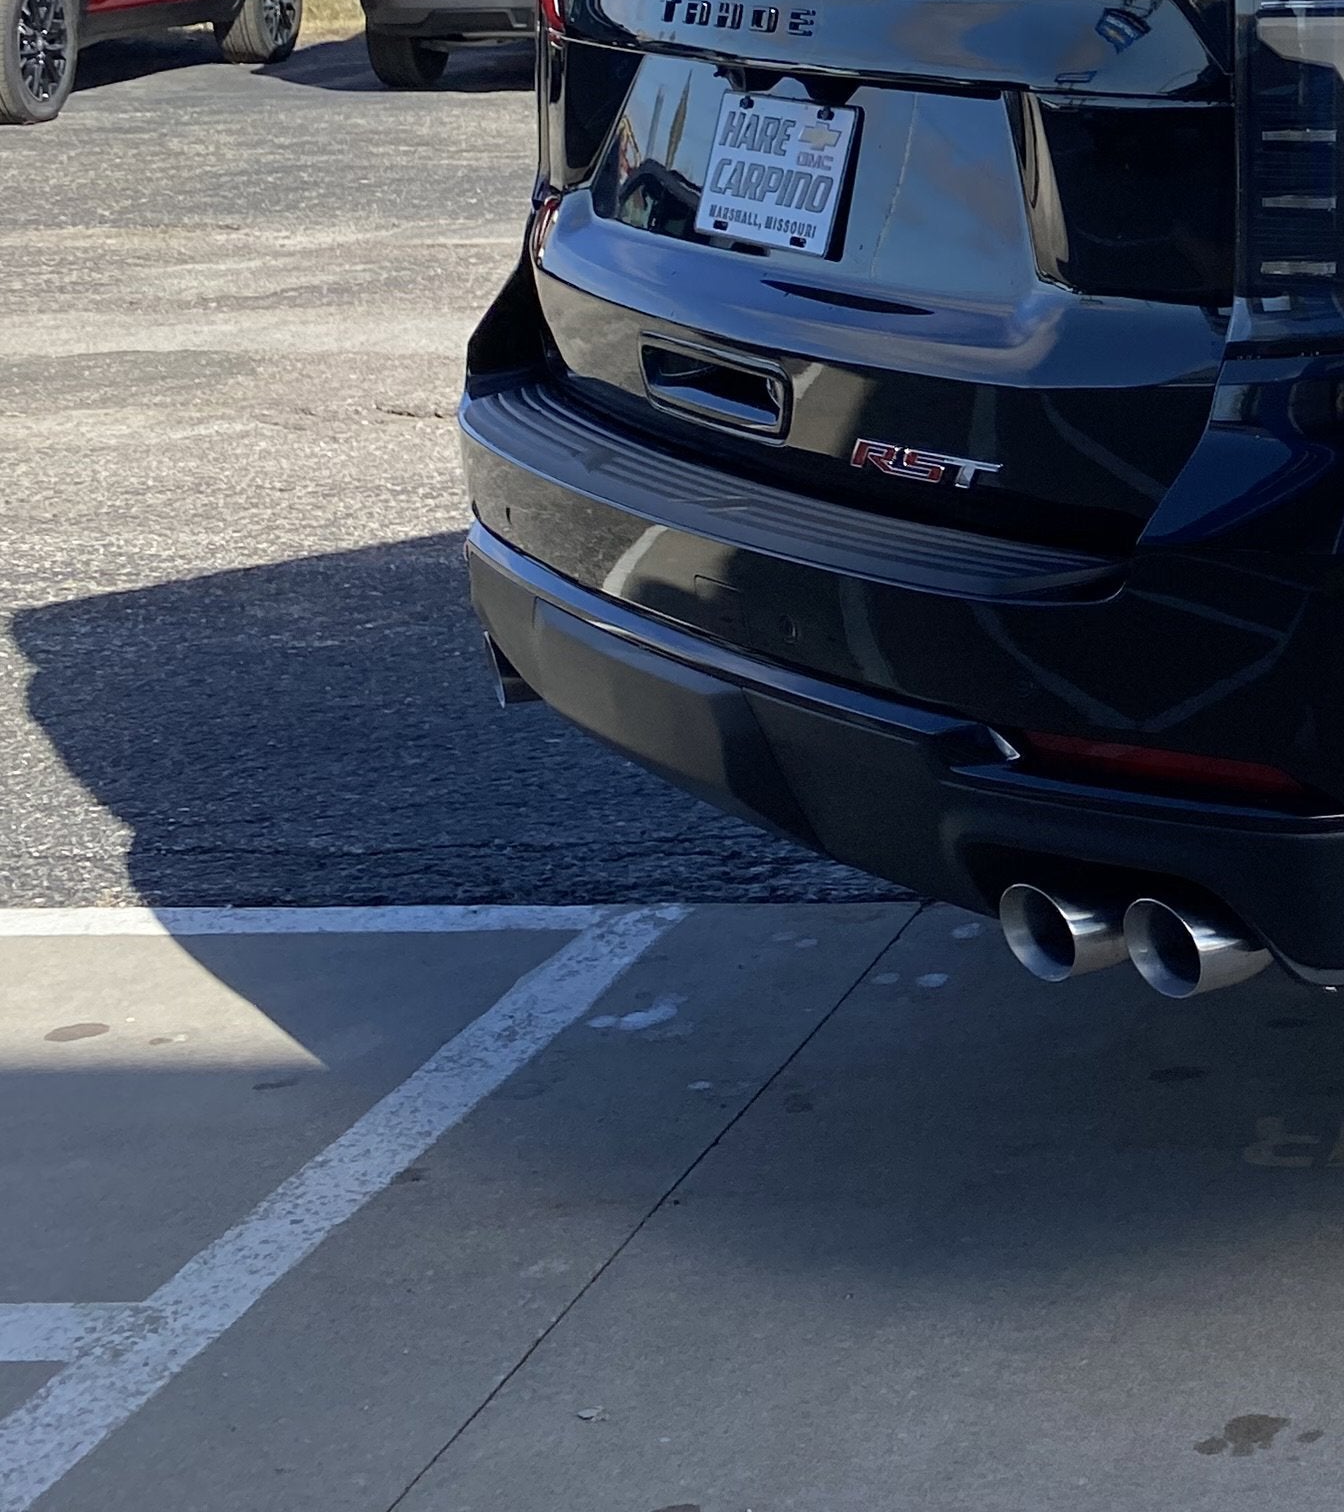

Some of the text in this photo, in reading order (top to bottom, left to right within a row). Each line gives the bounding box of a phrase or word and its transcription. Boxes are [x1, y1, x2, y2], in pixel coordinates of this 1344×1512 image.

[718, 110, 796, 157] HARE
[796, 151, 834, 171] GMC
[709, 157, 834, 214] CARPINO
[709, 204, 817, 239] MARSHALL, MISSOURI
[850, 438, 1003, 489] RST
